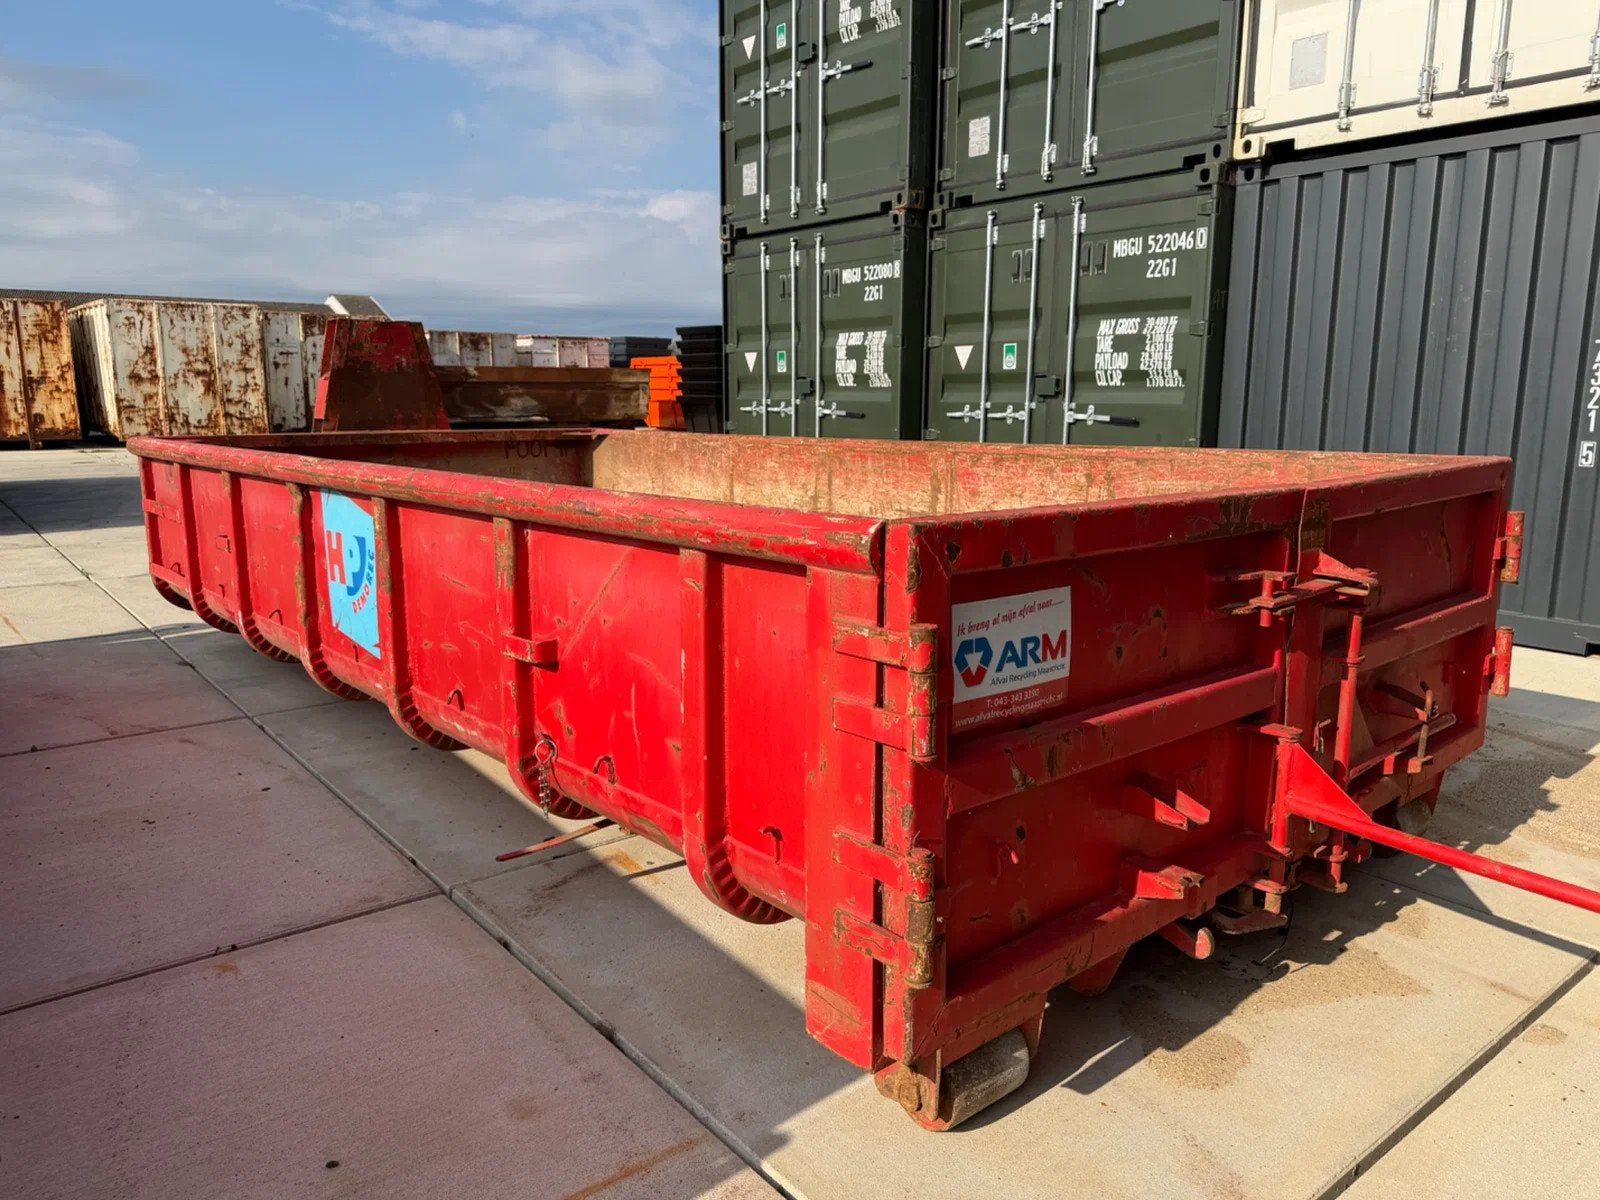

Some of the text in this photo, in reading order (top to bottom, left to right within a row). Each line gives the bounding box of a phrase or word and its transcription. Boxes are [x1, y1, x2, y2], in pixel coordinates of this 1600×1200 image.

[1113, 236, 1143, 258] MBGU
[1147, 231, 1194, 254] 522046
[1146, 257, 1177, 278] 22G1
[864, 285, 883, 301] 22G1
[1115, 318, 1140, 335] GROSS
[1097, 335, 1114, 353] TARE
[1095, 352, 1128, 370] PAYLOAD
[957, 621, 967, 637] Ik
[967, 617, 990, 634] breng
[992, 614, 1001, 628] al
[1001, 608, 1017, 625] mijn
[1017, 601, 1037, 620] afval
[995, 629, 1068, 673] ARM
[990, 663, 1066, 687] Afval Recycling Maastricht
